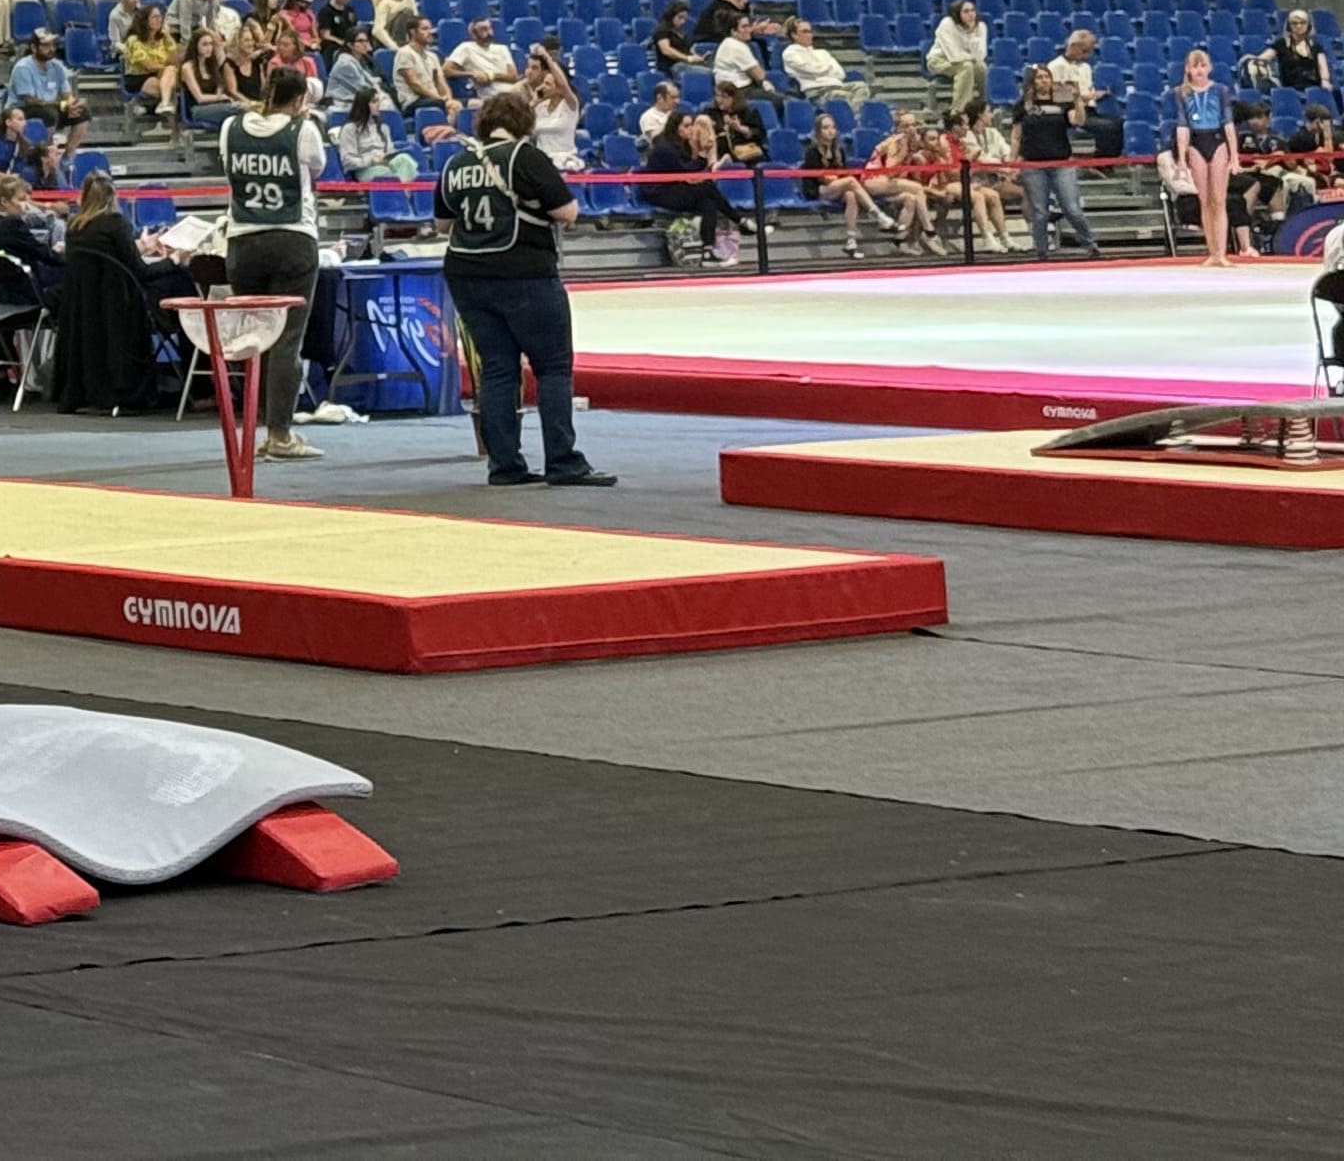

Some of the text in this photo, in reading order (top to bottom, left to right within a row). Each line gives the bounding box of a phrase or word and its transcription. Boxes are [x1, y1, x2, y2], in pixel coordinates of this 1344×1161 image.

[231, 153, 294, 177] MEDIA
[245, 182, 284, 210] 29
[460, 195, 494, 231] 14
[1042, 405, 1097, 420] GYMNOVA
[123, 595, 241, 635] GYMNOVA
